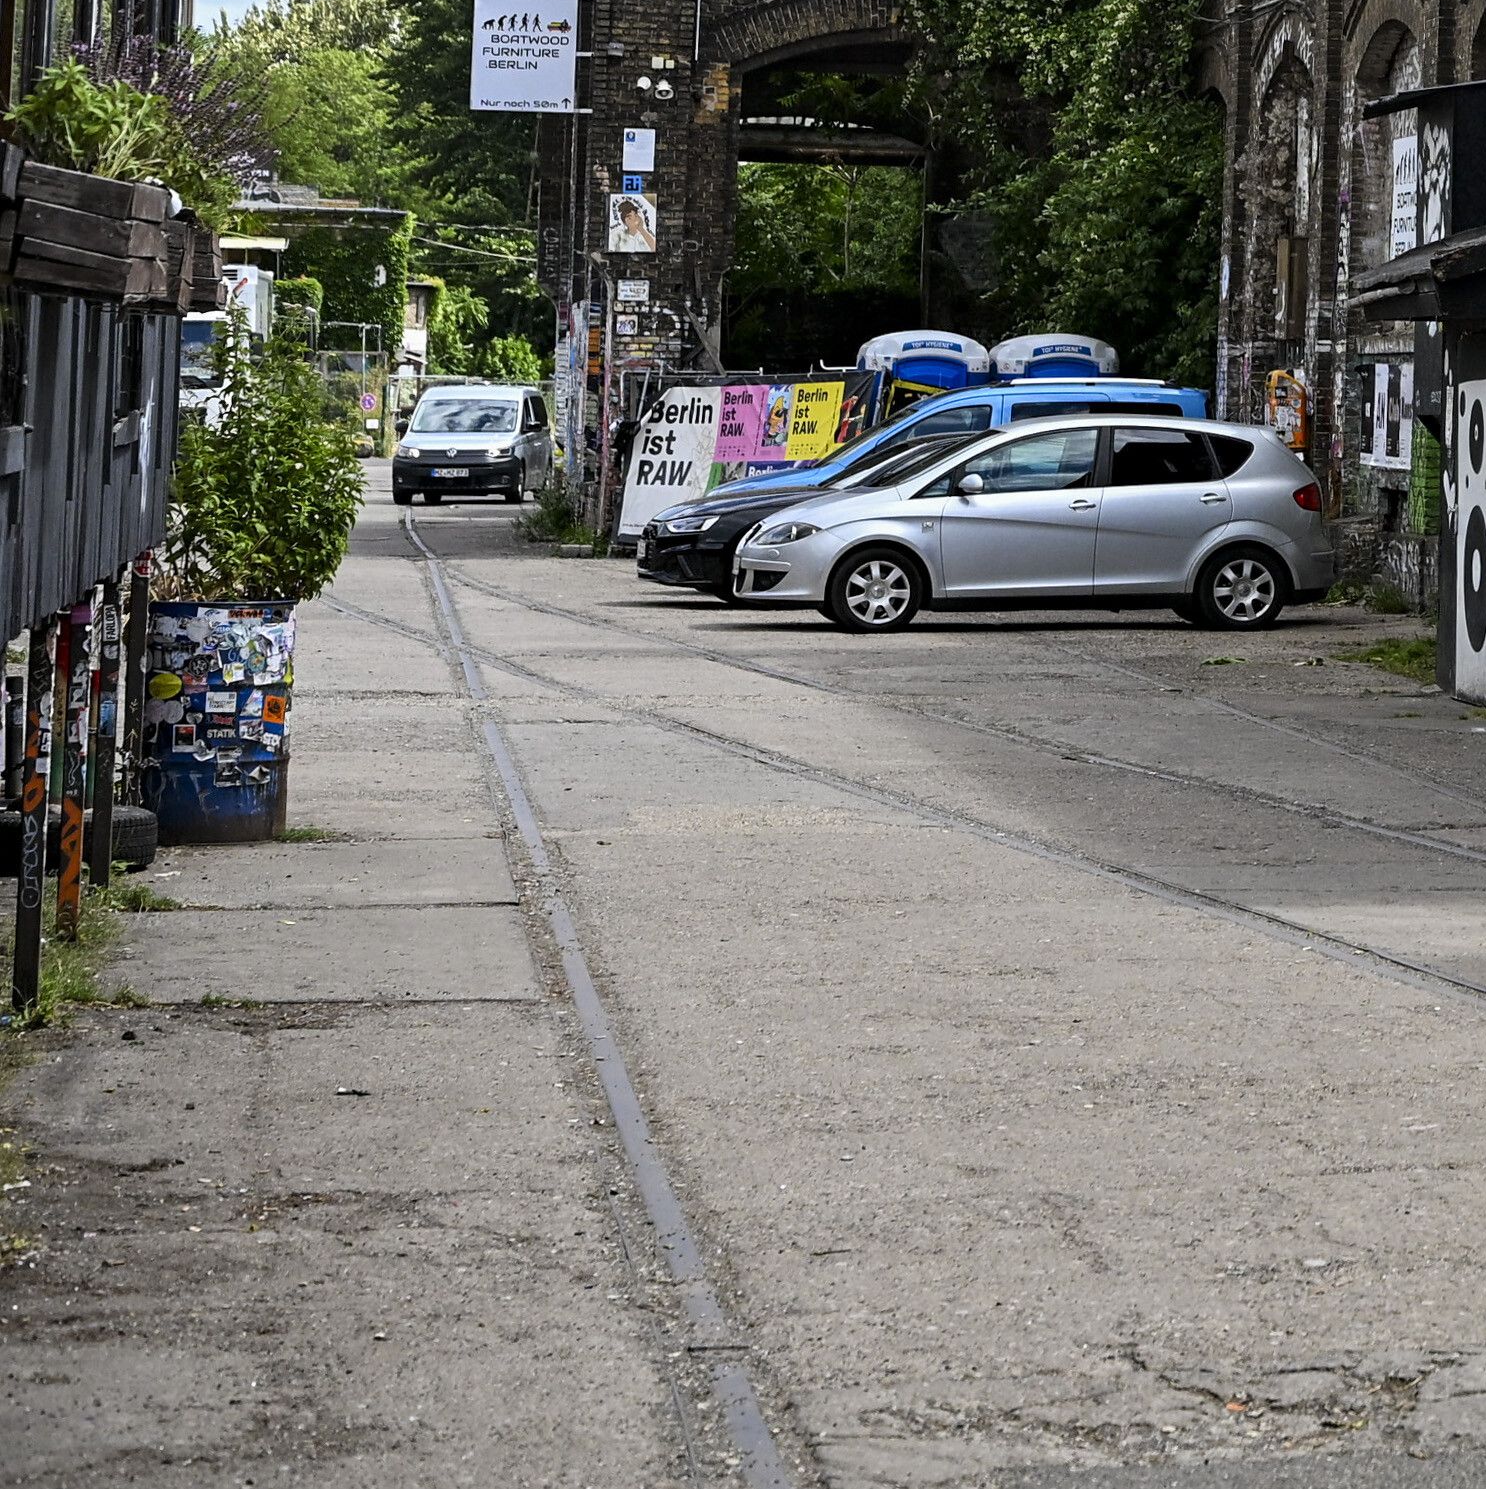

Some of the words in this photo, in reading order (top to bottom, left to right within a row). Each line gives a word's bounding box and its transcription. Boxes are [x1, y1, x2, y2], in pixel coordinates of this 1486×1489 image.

[491, 34, 569, 45] BOATWOOD
[482, 47, 559, 58] FURNITURE
[481, 99, 500, 107] Nur
[504, 99, 530, 108] noch
[724, 390, 753, 405] Berlin
[797, 388, 828, 402] Berlin
[650, 397, 713, 424] Berlin
[722, 407, 736, 422] ist
[795, 404, 810, 419] ist
[642, 429, 676, 455] ist
[207, 728, 236, 738] STATIK
